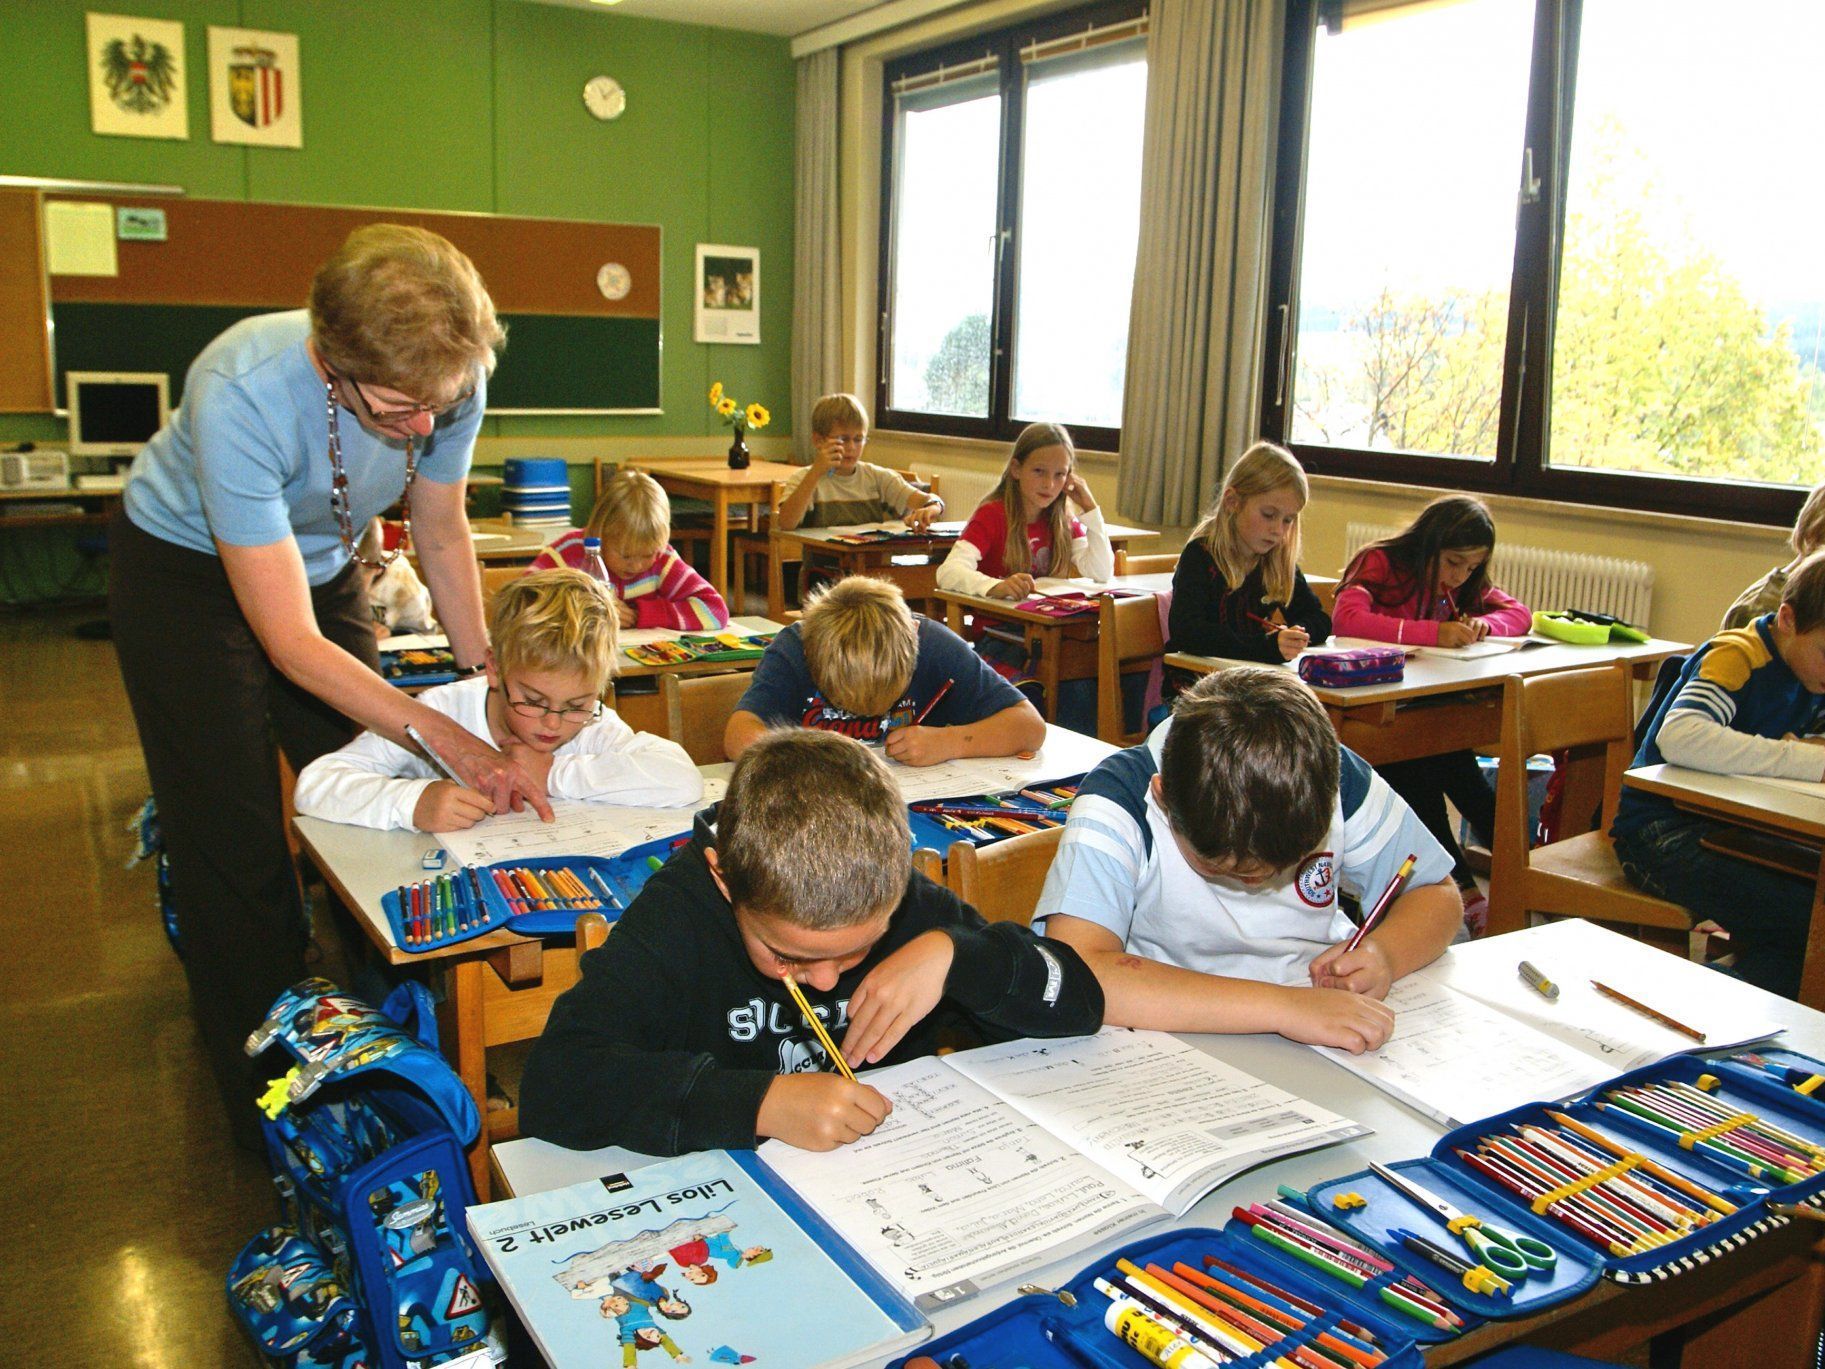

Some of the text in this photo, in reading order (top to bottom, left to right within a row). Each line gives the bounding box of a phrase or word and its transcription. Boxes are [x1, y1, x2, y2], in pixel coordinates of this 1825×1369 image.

[944, 1155, 983, 1171] Fatima
[496, 1179, 733, 1253] Lilos Lesewelt 2
[489, 1220, 535, 1235] Lesebuch
